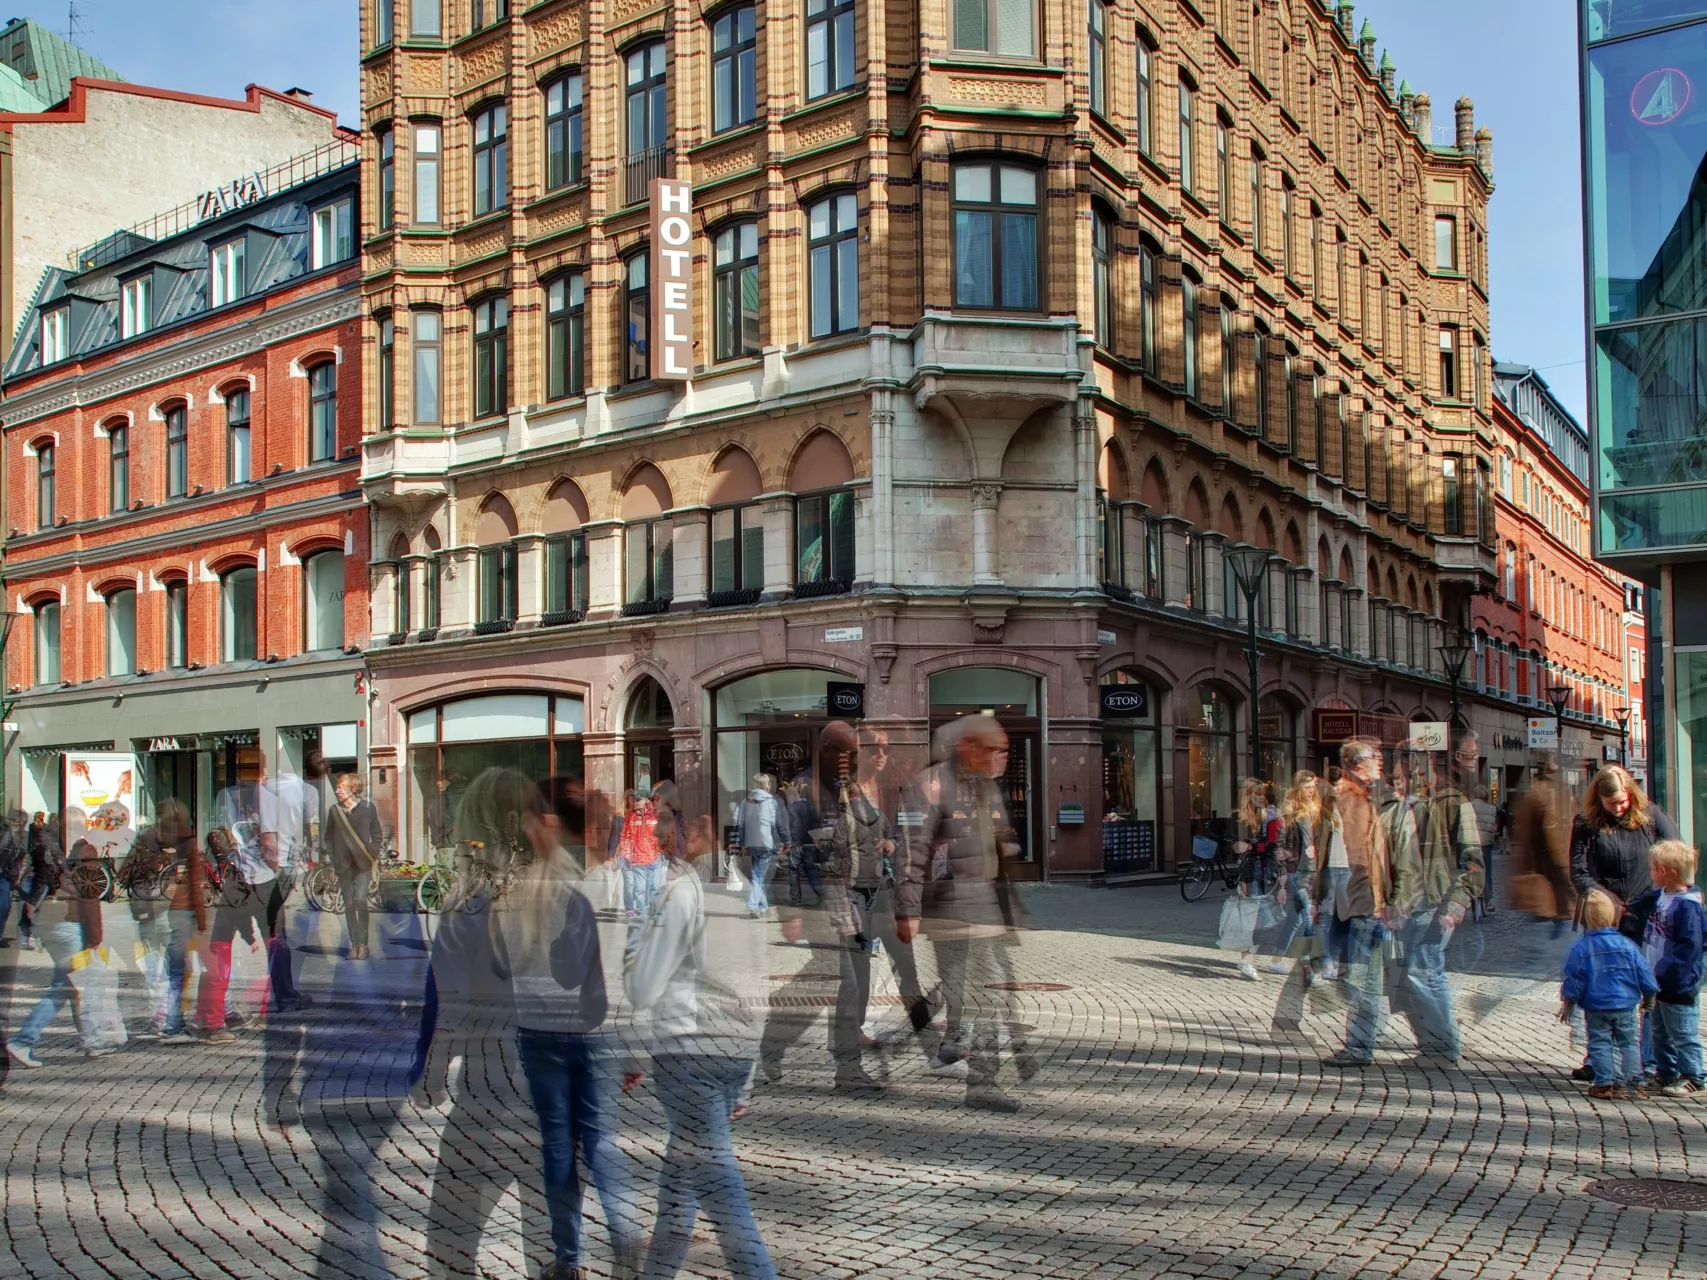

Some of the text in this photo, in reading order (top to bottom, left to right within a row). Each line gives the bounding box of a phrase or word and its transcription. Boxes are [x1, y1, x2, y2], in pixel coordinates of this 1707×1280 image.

[196, 171, 266, 224] ZARA
[660, 184, 690, 374] HOTELL
[836, 695, 858, 705] ETON
[1109, 696, 1138, 705] ETON
[148, 736, 180, 751] ZARA
[770, 748, 799, 759] ETON
